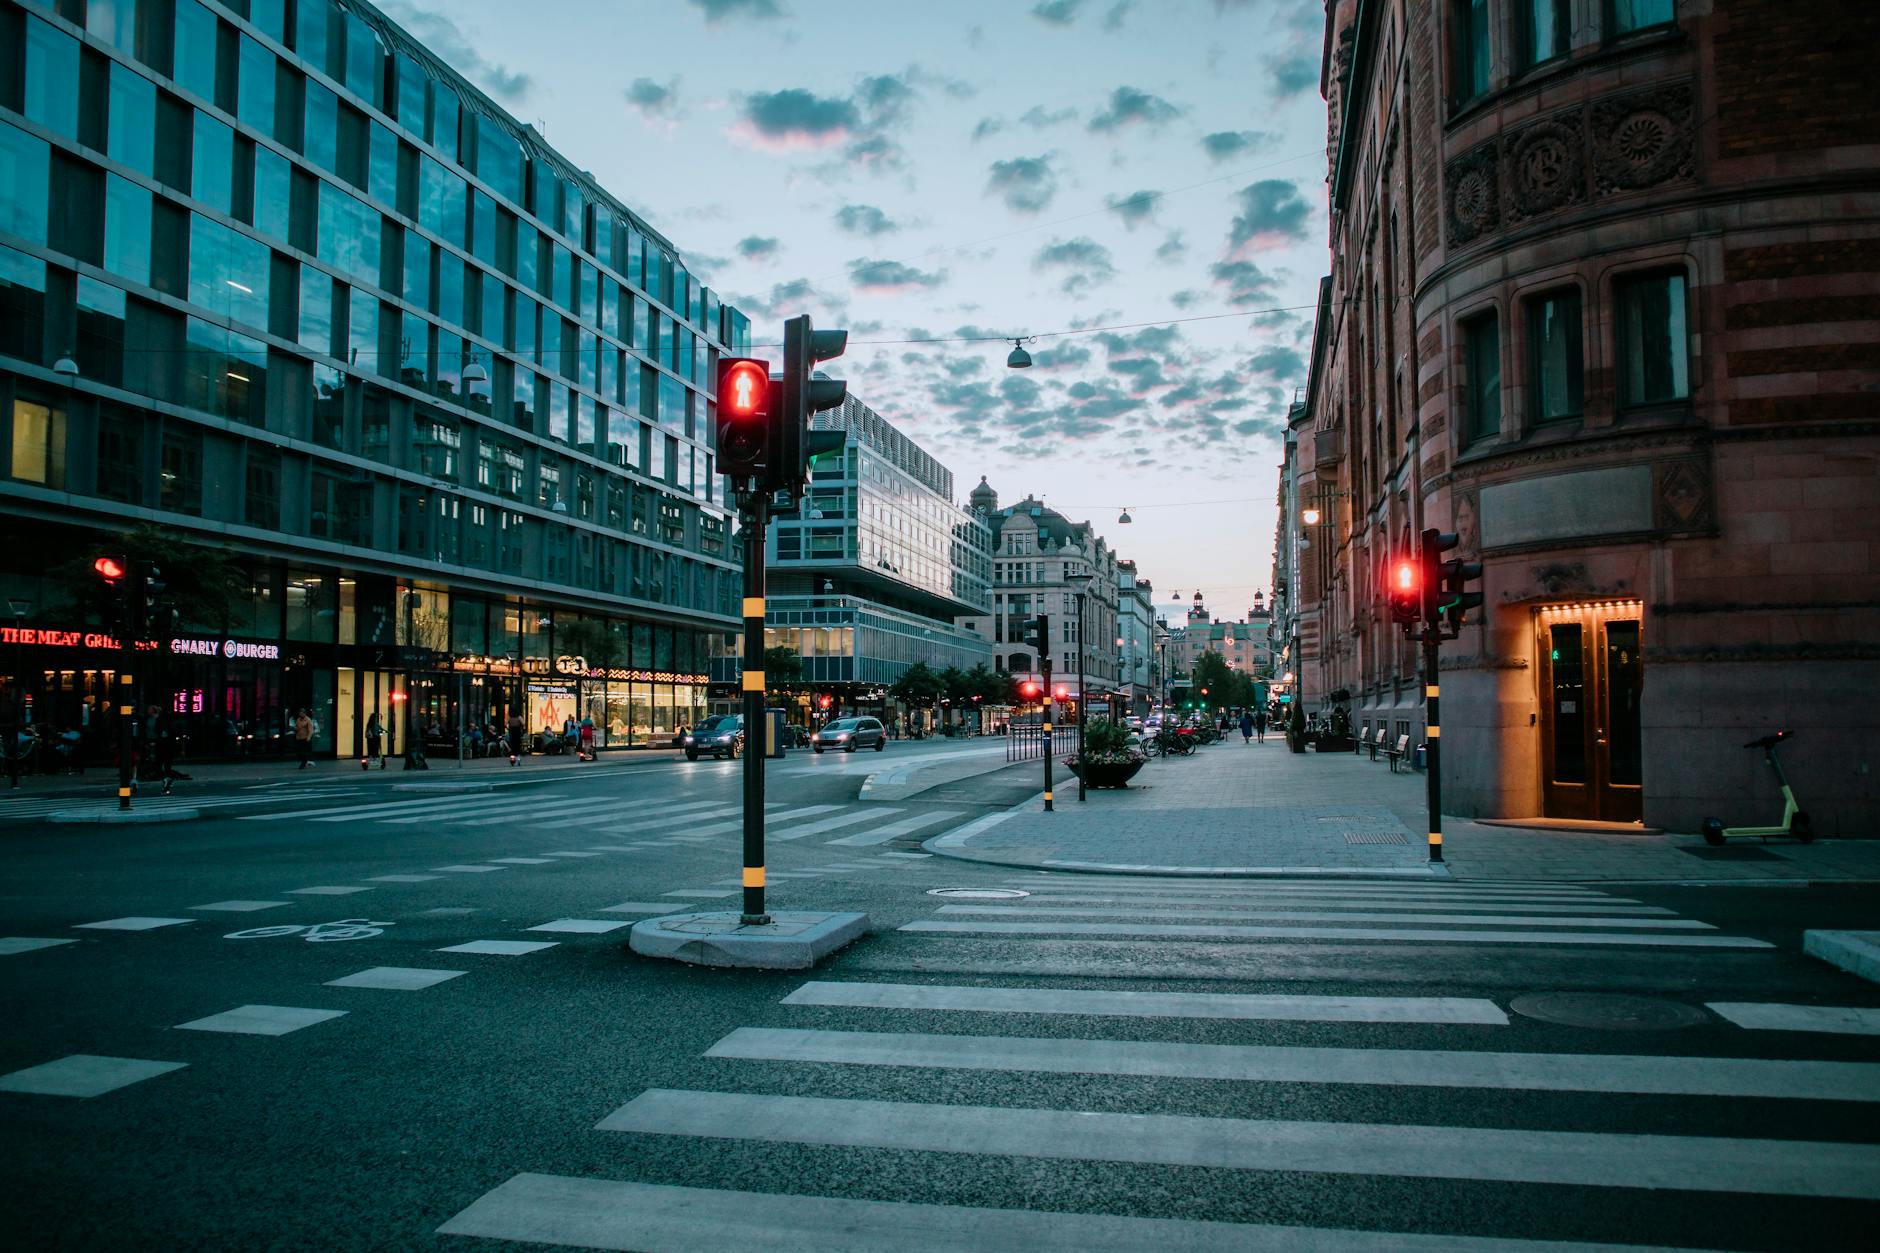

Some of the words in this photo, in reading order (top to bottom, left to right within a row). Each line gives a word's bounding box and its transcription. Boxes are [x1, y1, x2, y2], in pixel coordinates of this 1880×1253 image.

[1, 627, 36, 643] THE
[37, 629, 81, 646] MEAT
[172, 639, 219, 656] GNARLY
[236, 642, 279, 659] BURGER
[539, 699, 560, 726] MAX
